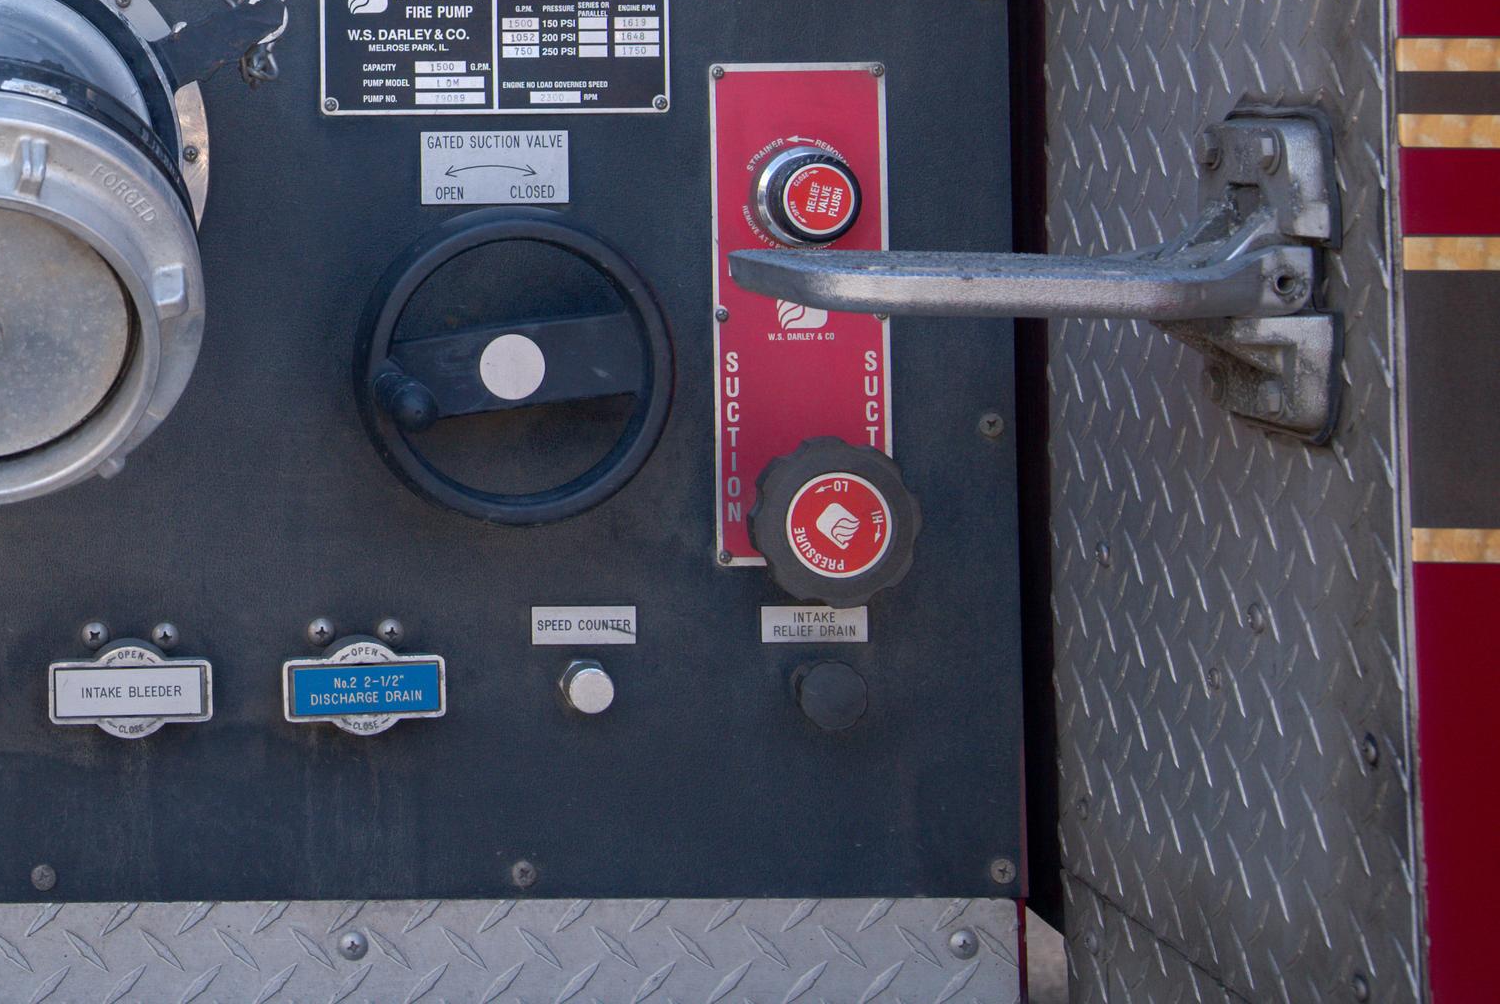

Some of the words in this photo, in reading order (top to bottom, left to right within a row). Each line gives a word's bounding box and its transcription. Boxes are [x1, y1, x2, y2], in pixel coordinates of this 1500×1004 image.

[405, 6, 432, 18] FIRE
[438, 5, 473, 18] PUMP
[348, 30, 376, 41] W.S.
[378, 29, 432, 41] DARLEY
[434, 29, 443, 41] &
[445, 29, 470, 40] CO.
[514, 47, 533, 56] 750
[542, 48, 558, 56] 250
[622, 46, 647, 55] 1750
[427, 136, 464, 149] GATED
[470, 135, 520, 149] SUCTION
[526, 135, 563, 148] VALVE
[746, 138, 784, 172] STRAINER
[90, 162, 158, 224] FORGED
[435, 186, 464, 200] OPEN
[510, 185, 555, 199] CLOSED
[805, 181, 820, 213] RELIEF
[817, 185, 832, 213] VALVE
[828, 187, 844, 217] FLUSH
[768, 333, 784, 341] W.S.
[787, 333, 815, 341] DARLEY
[825, 332, 835, 340] CO
[725, 351, 741, 523] SUCTION
[833, 480, 849, 492] LO
[871, 510, 884, 524] HI
[794, 526, 845, 571] PRESSURE
[793, 612, 836, 624] INTAKE
[537, 620, 572, 631] SPEED
[578, 619, 632, 631] COUNTER
[772, 625, 814, 637] RELIEF
[820, 625, 856, 637] DRAIN
[117, 650, 144, 660] OPEN
[351, 646, 378, 656] OPEN
[333, 677, 357, 689] No.2
[364, 675, 404, 688] 2-1/2"
[81, 687, 122, 698] INTAKE
[129, 685, 182, 698] BLEEDER
[310, 692, 379, 706] DISCHARGE
[385, 690, 422, 702] DRAIN
[118, 724, 144, 734] CLOSE
[352, 721, 379, 731] CLOSE
